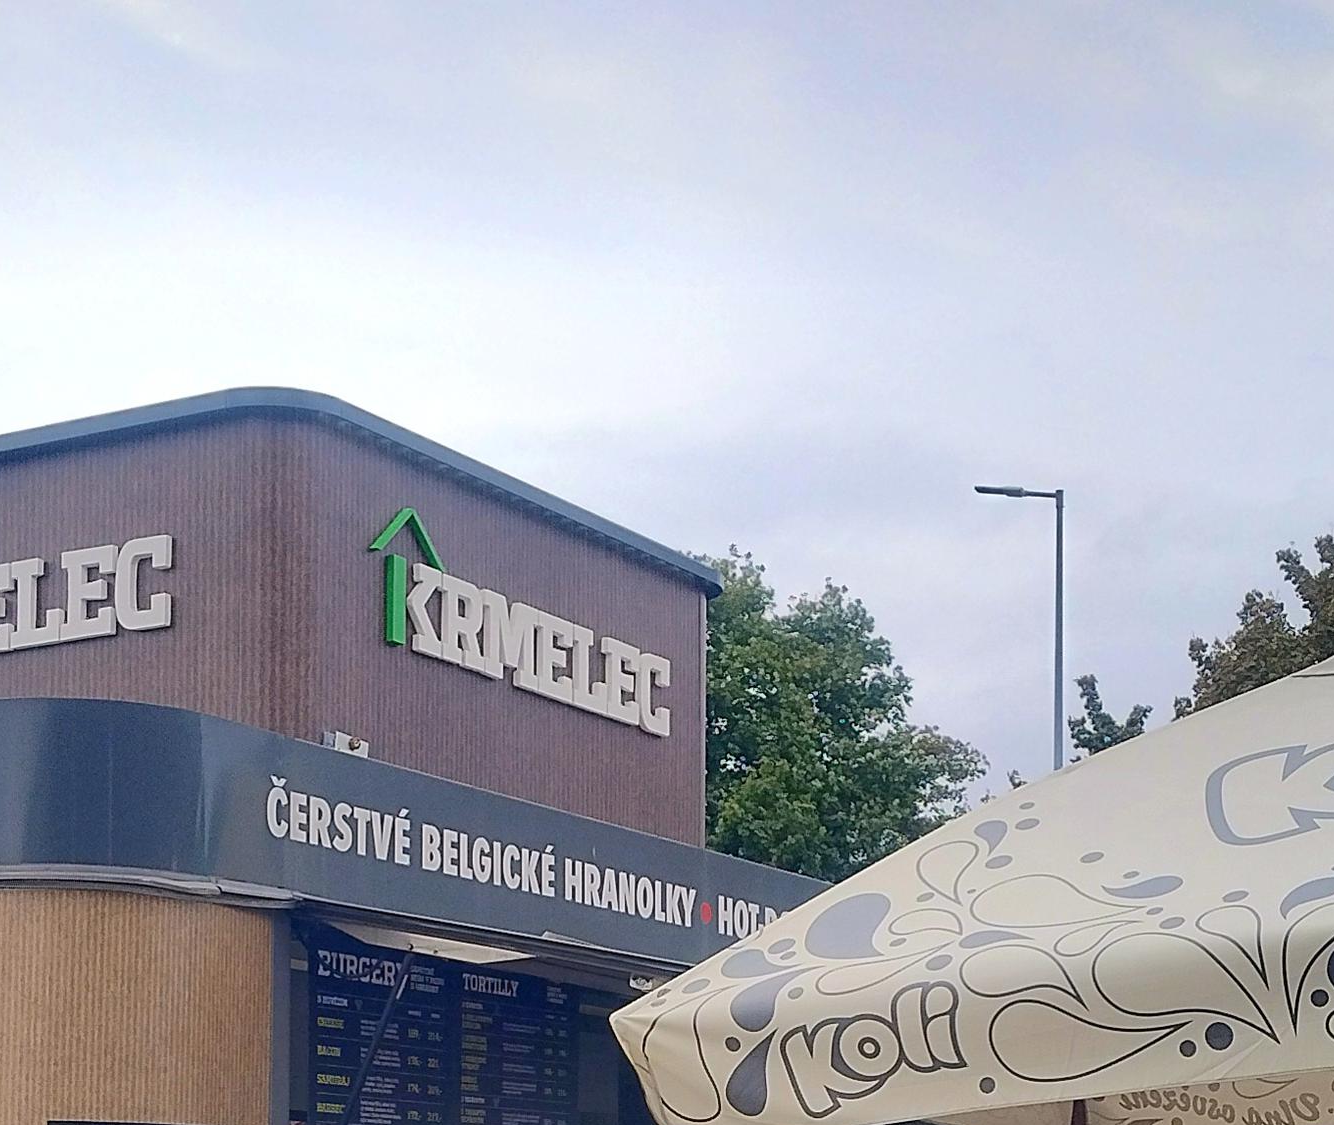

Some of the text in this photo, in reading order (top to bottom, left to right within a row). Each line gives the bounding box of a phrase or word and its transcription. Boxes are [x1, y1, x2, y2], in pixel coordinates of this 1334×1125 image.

[405, 562, 673, 738] KRMELEC
[266, 775, 411, 866] ČERSTVÉ
[420, 824, 556, 897] BELGICKÉ
[564, 857, 697, 928] HRANOLKY
[462, 973, 520, 998] TORTILLY
